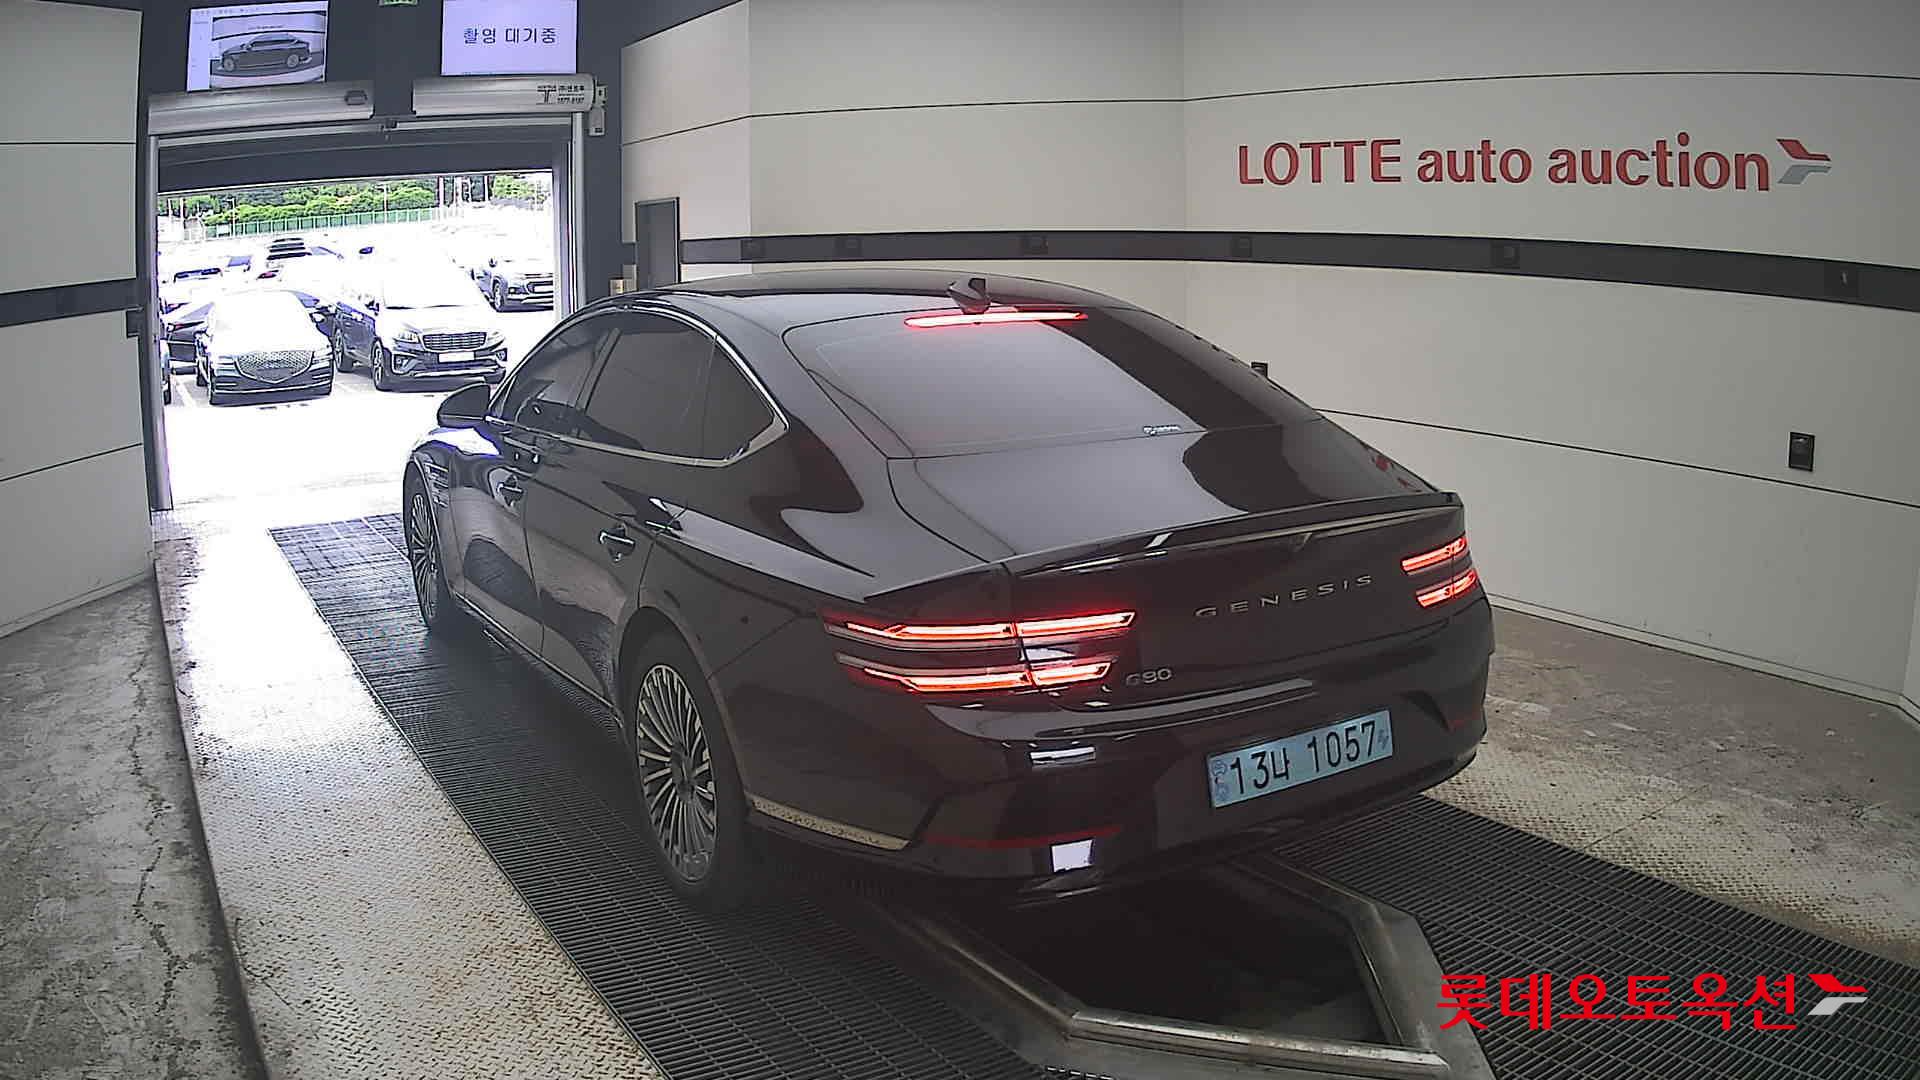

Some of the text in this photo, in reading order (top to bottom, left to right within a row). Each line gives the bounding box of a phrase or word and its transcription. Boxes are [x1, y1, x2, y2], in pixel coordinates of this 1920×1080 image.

[463, 27, 557, 44] 촬영 대기중
[1239, 131, 1770, 191] LOTTE auto auction
[1195, 574, 1373, 617] GENESIS
[1230, 720, 1376, 794] 13나 1057
